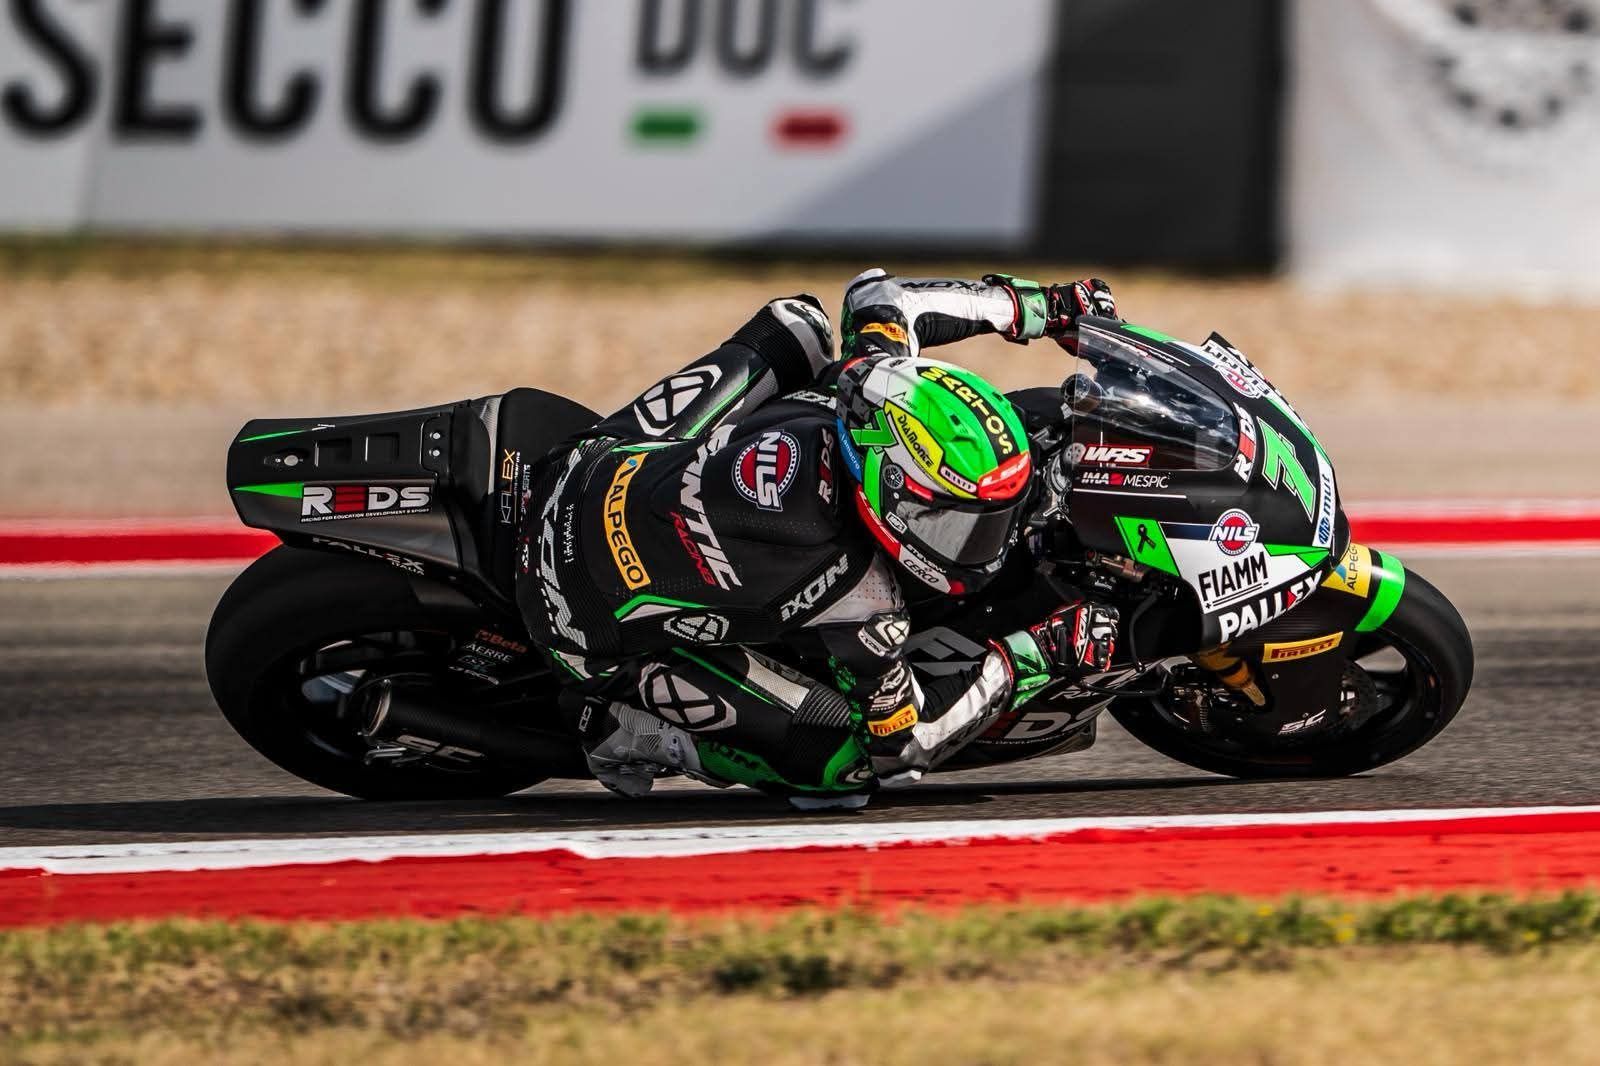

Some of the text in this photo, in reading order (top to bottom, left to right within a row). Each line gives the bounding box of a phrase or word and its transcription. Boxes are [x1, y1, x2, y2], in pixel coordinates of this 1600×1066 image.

[1084, 446, 1150, 463] WRS
[755, 431, 782, 508] NILS
[1123, 474, 1169, 488] MESPIC
[1256, 415, 1317, 523] 7
[301, 486, 431, 516] REDS
[366, 509, 405, 517] DEVELOPMENT
[607, 484, 645, 584] ALPEGO
[1211, 526, 1258, 541] NILS
[903, 558, 939, 584] CERCO
[1198, 551, 1268, 602] FIAMM
[1219, 570, 1322, 643] PALLEX
[466, 642, 514, 664] AERRE
[1271, 638, 1335, 659] PIRELLI
[872, 708, 915, 736] PIRELLI
